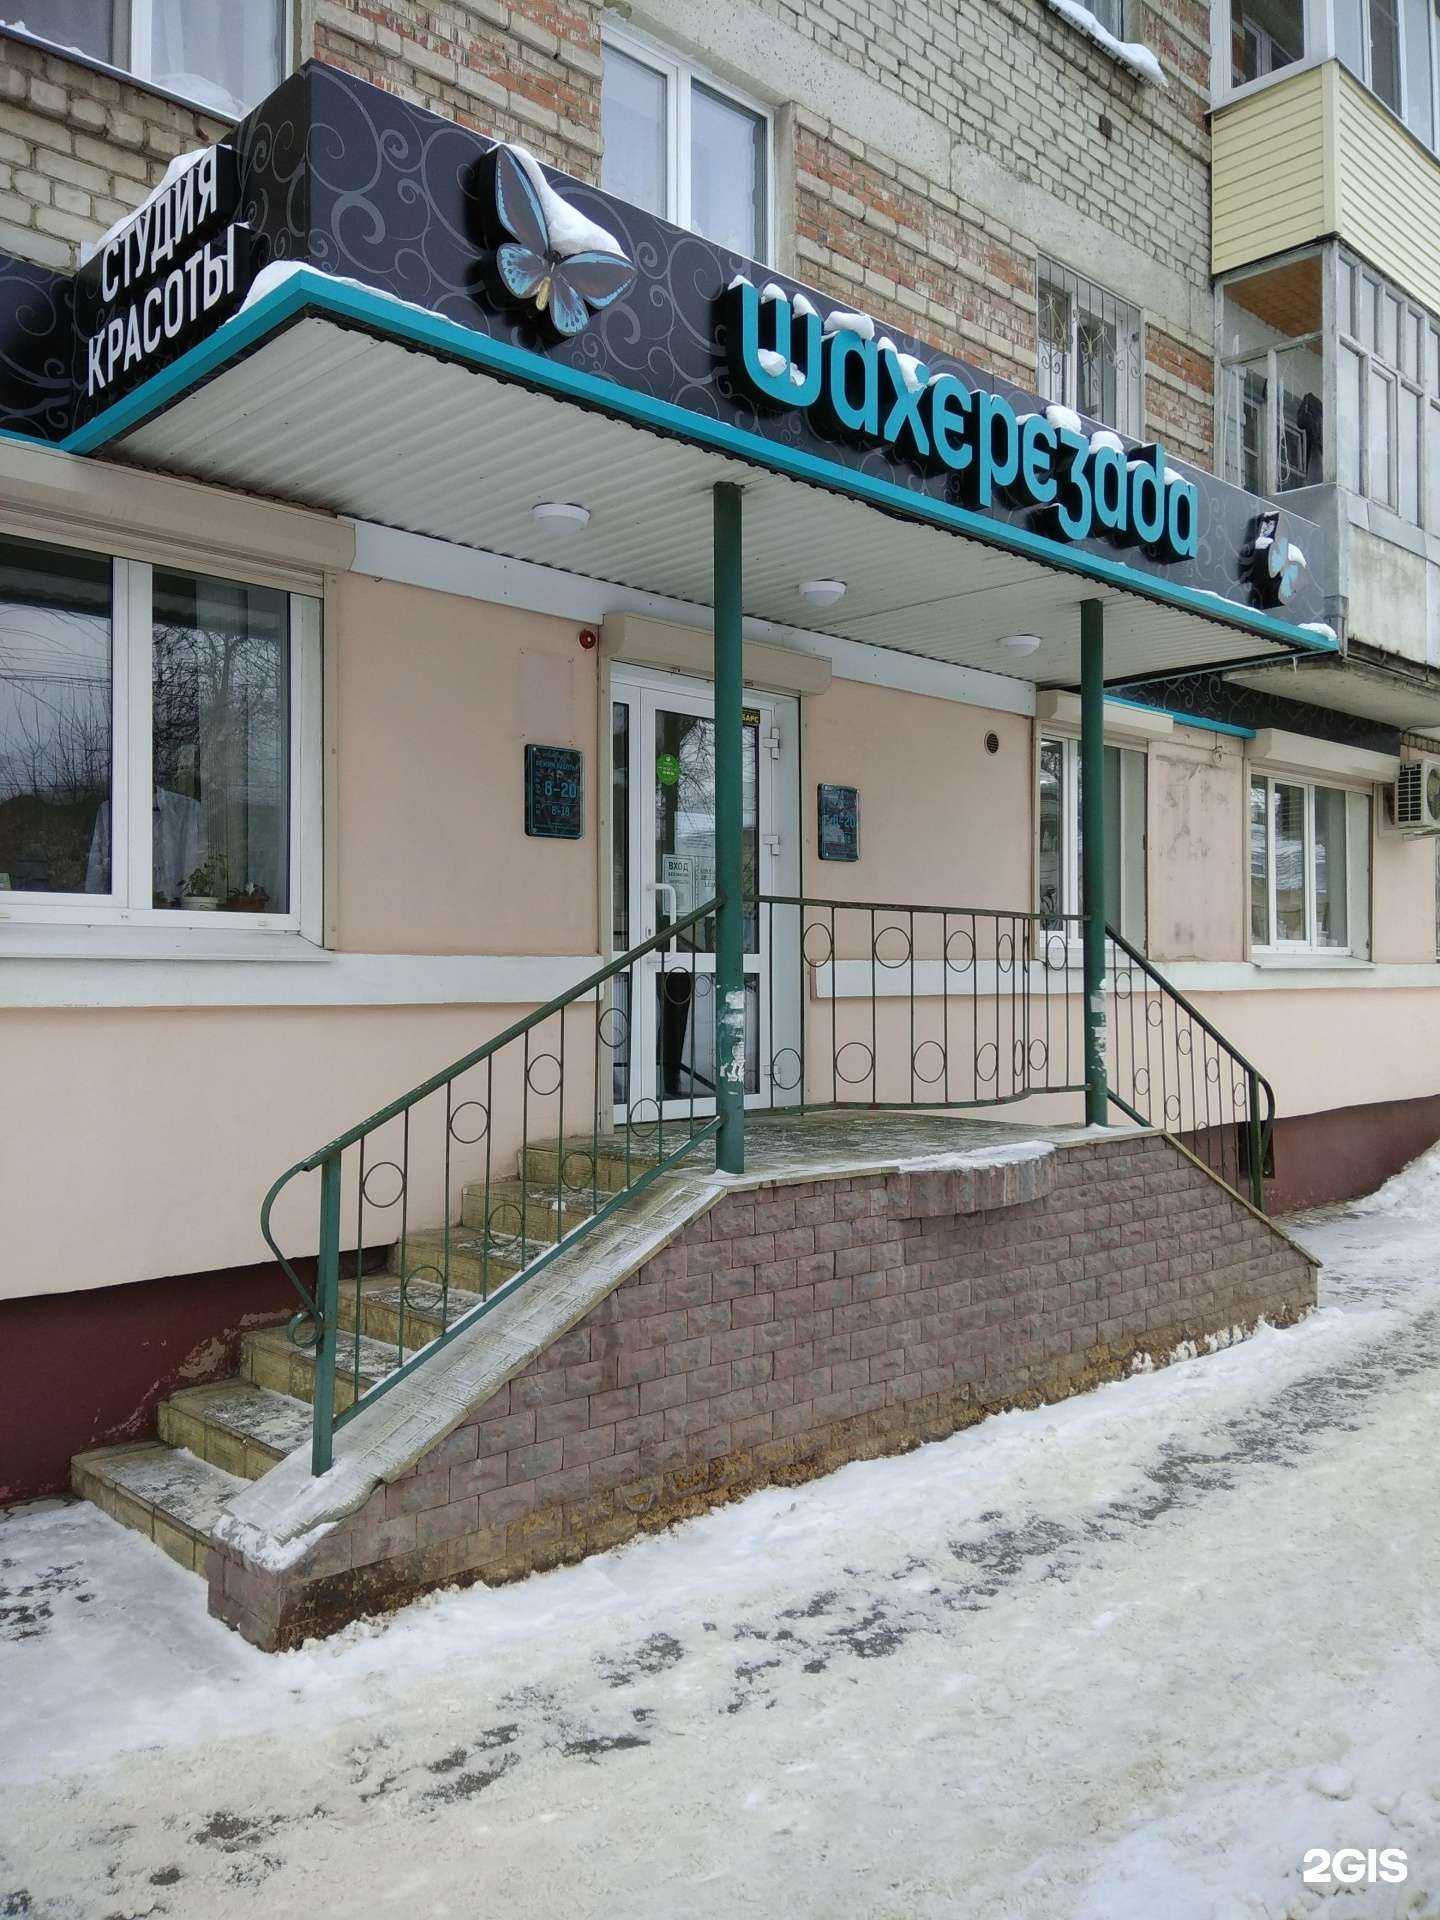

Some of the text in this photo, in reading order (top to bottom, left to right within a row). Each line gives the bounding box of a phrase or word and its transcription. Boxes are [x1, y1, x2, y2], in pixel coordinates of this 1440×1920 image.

[102, 152, 217, 303] СТУДИЯ
[88, 224, 235, 397] КРАСОТЫ
[668, 861, 689, 872] ВХОД
